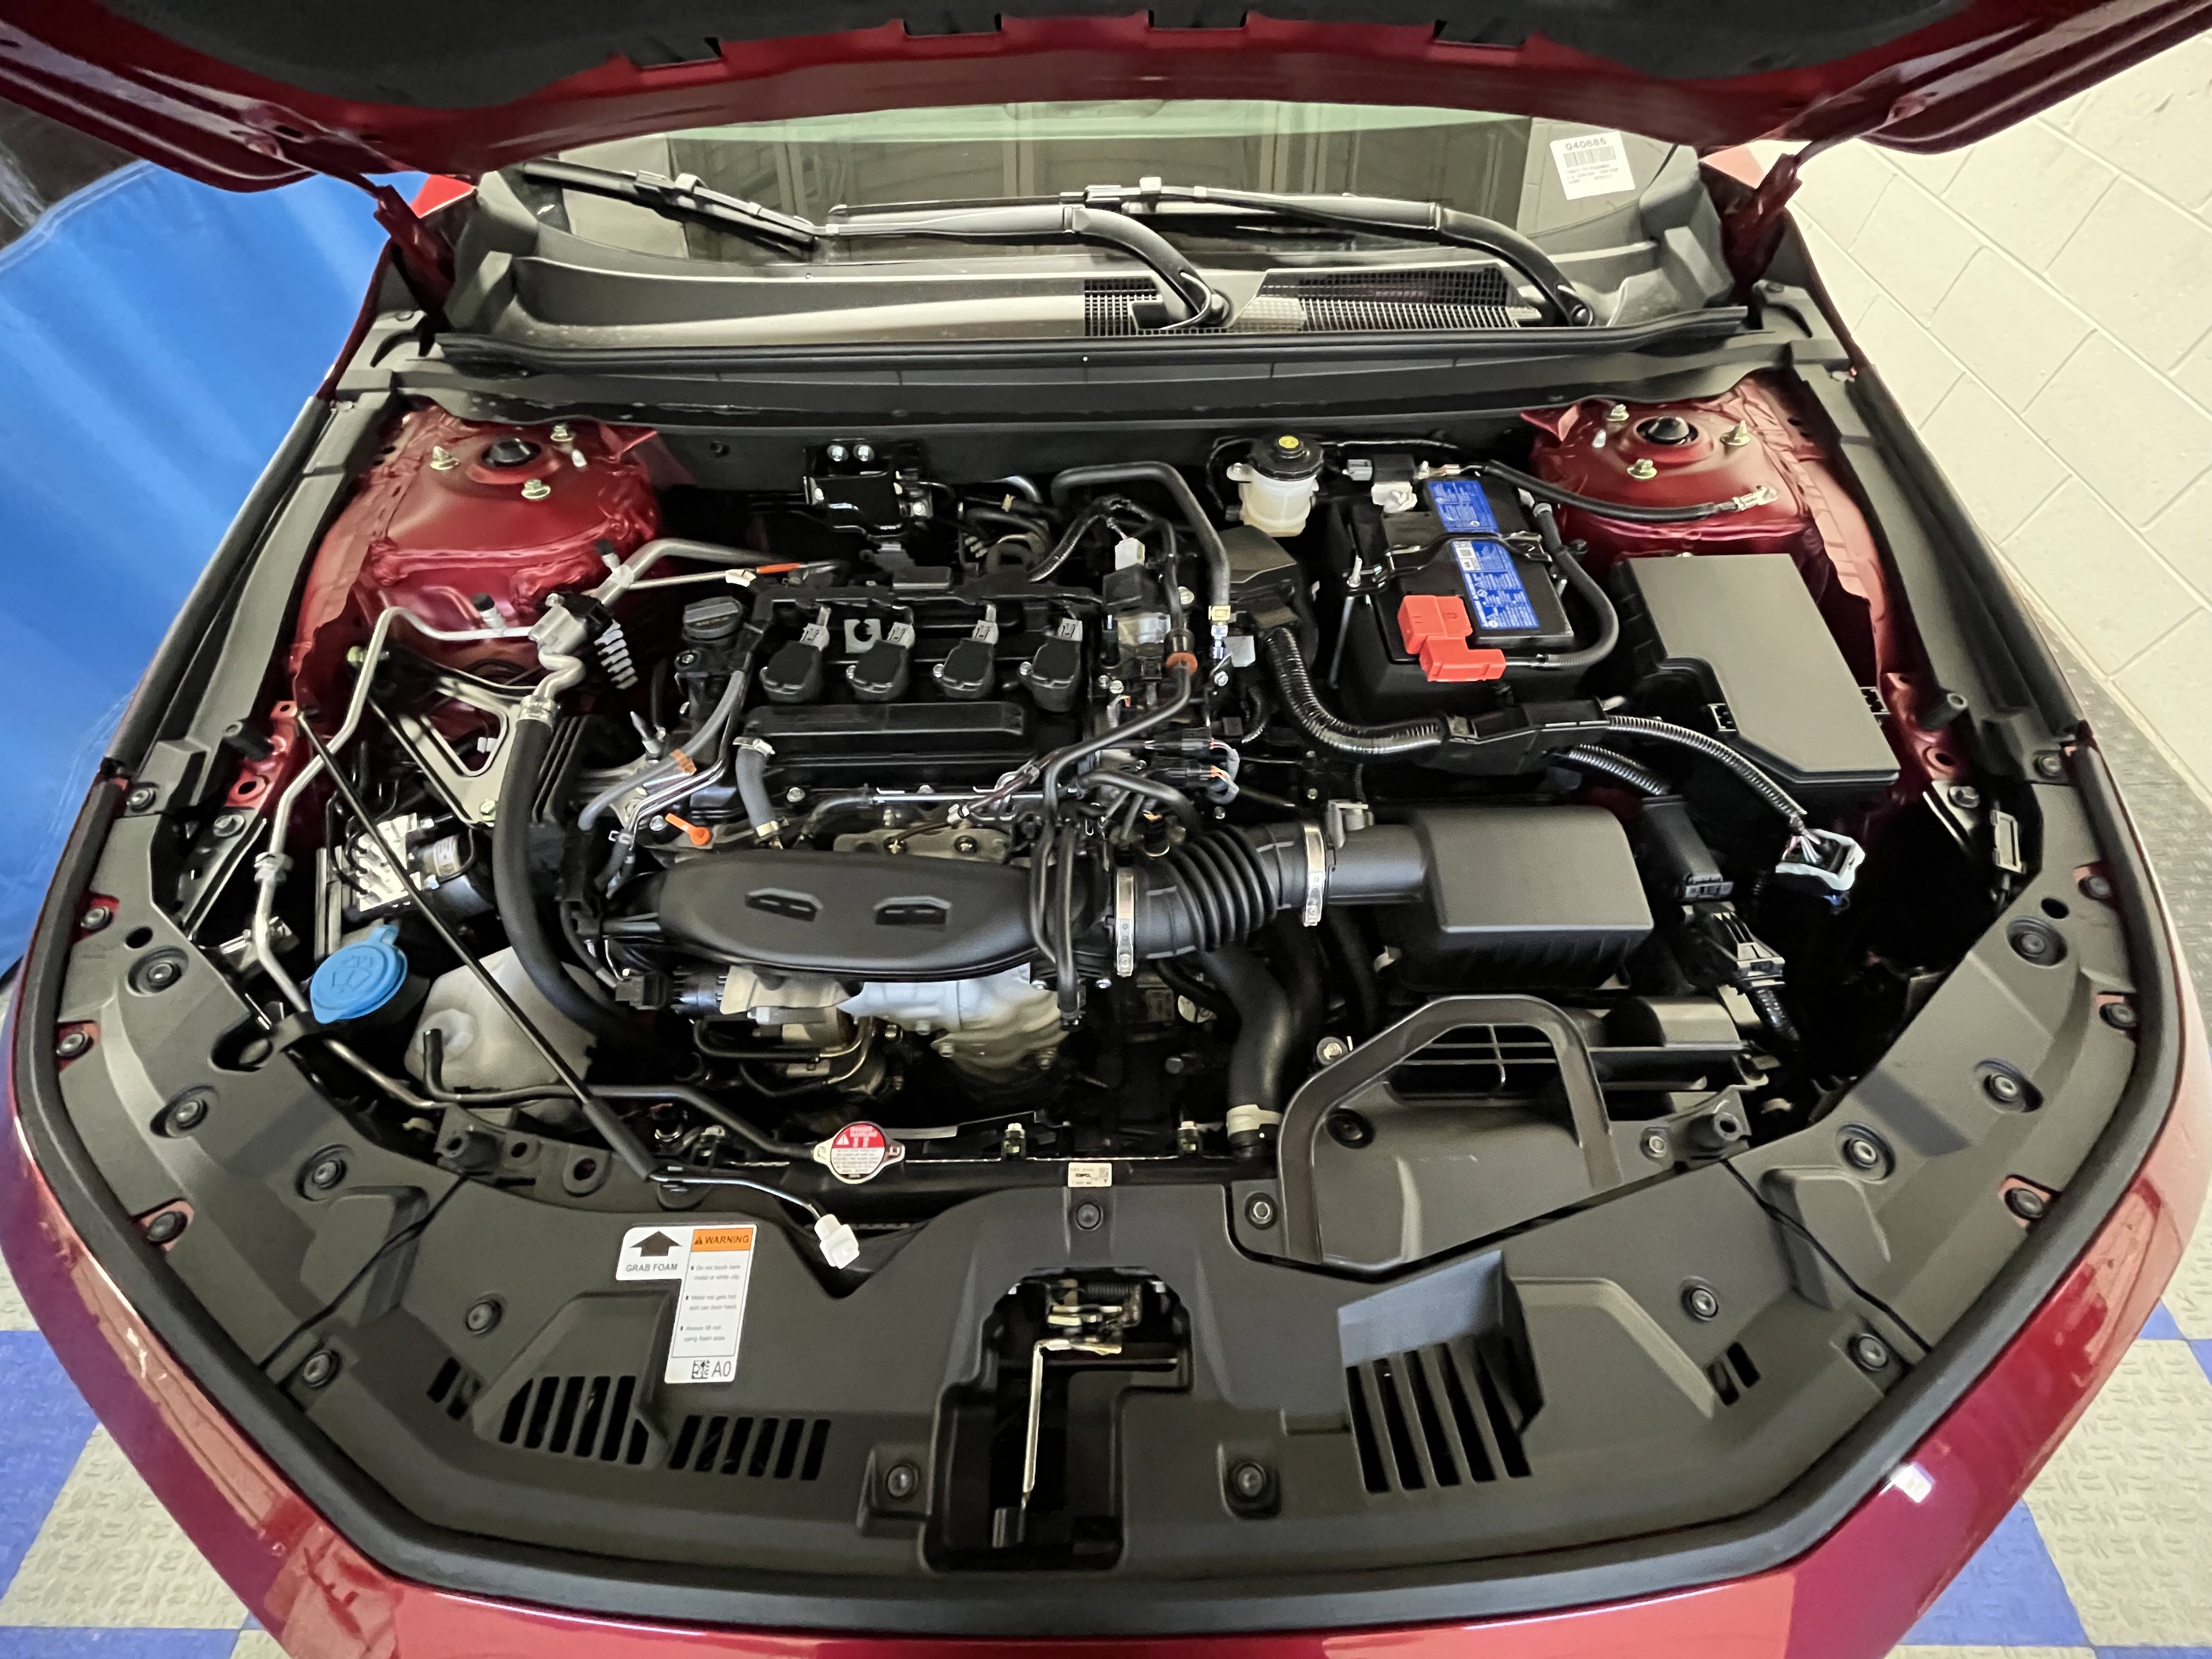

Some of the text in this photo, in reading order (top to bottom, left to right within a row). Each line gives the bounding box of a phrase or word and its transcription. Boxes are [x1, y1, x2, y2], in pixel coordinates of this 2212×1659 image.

[705, 1234, 750, 1244] WARNING
[625, 1263, 678, 1272] GRAB FOAM
